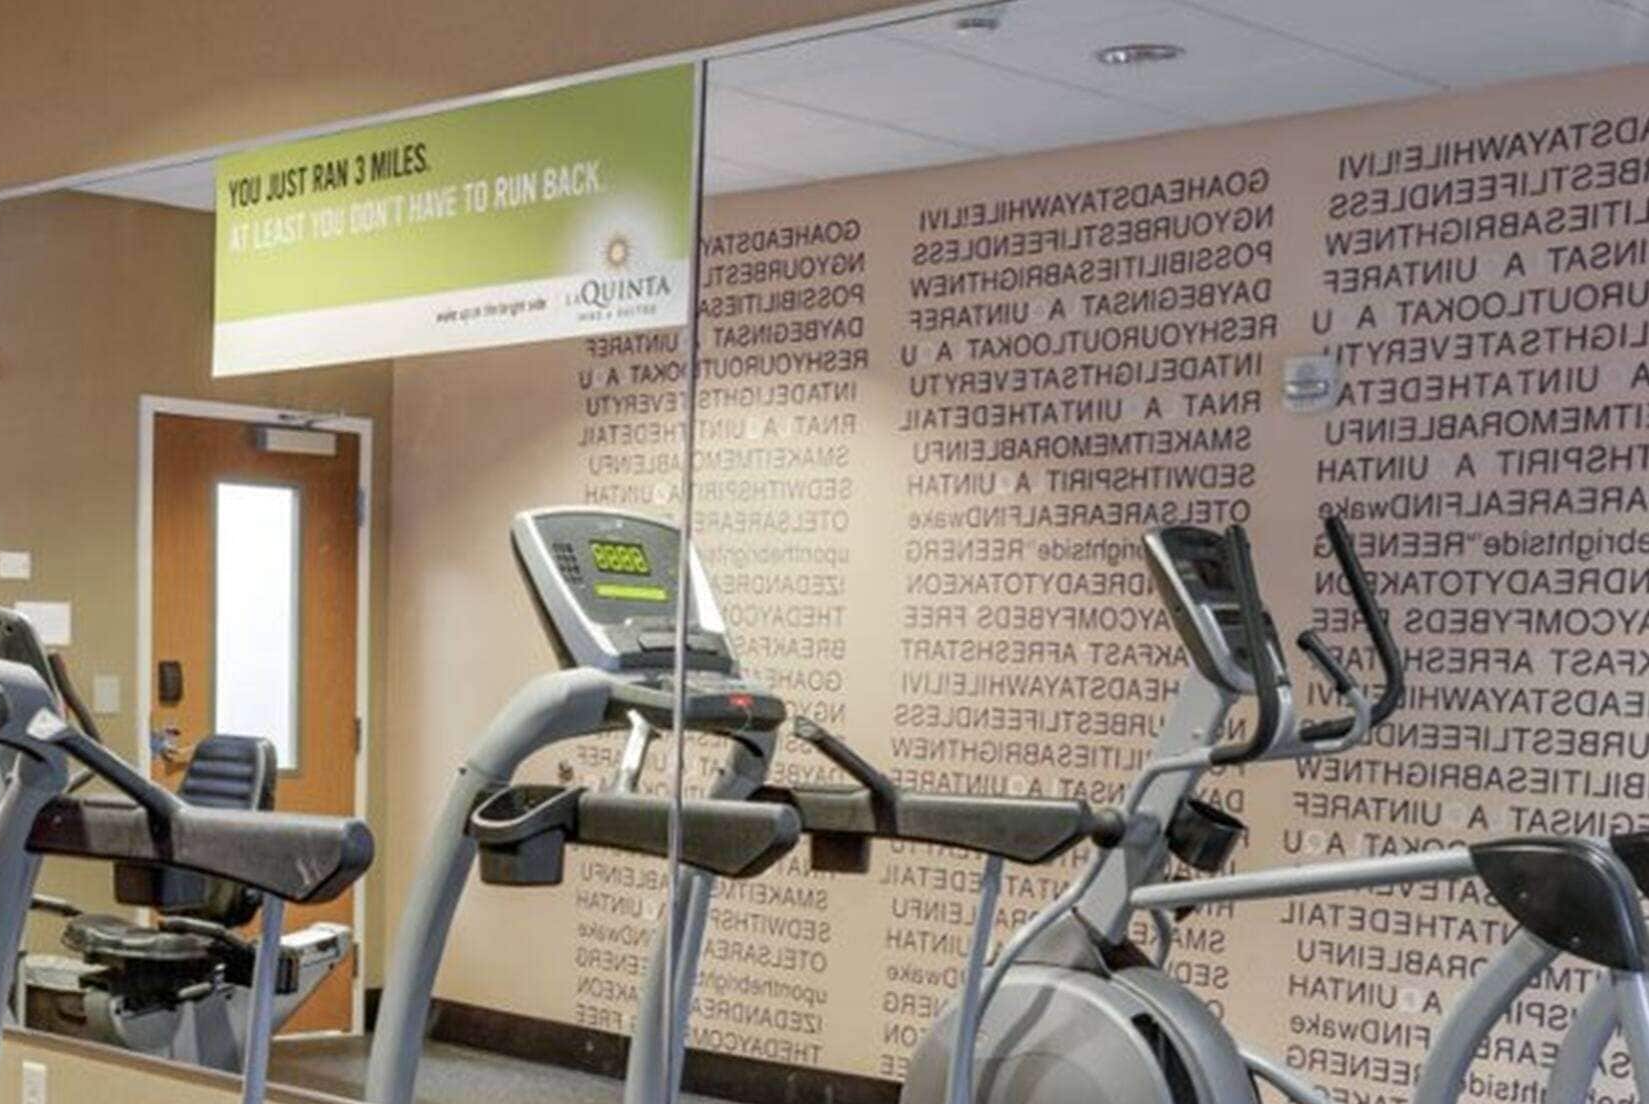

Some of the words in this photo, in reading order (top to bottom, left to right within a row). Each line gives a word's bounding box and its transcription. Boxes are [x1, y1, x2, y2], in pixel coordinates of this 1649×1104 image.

[229, 174, 261, 208] YOU
[266, 166, 308, 201] JUST
[312, 158, 348, 193] RAN
[355, 155, 366, 186] 3
[229, 219, 249, 254] AT
[254, 211, 307, 250] LEAST
[312, 205, 345, 238] YOU
[408, 185, 457, 222] HAVE
[464, 180, 488, 213] TO
[494, 170, 538, 210] RUN
[580, 276, 671, 308] QUINTA
